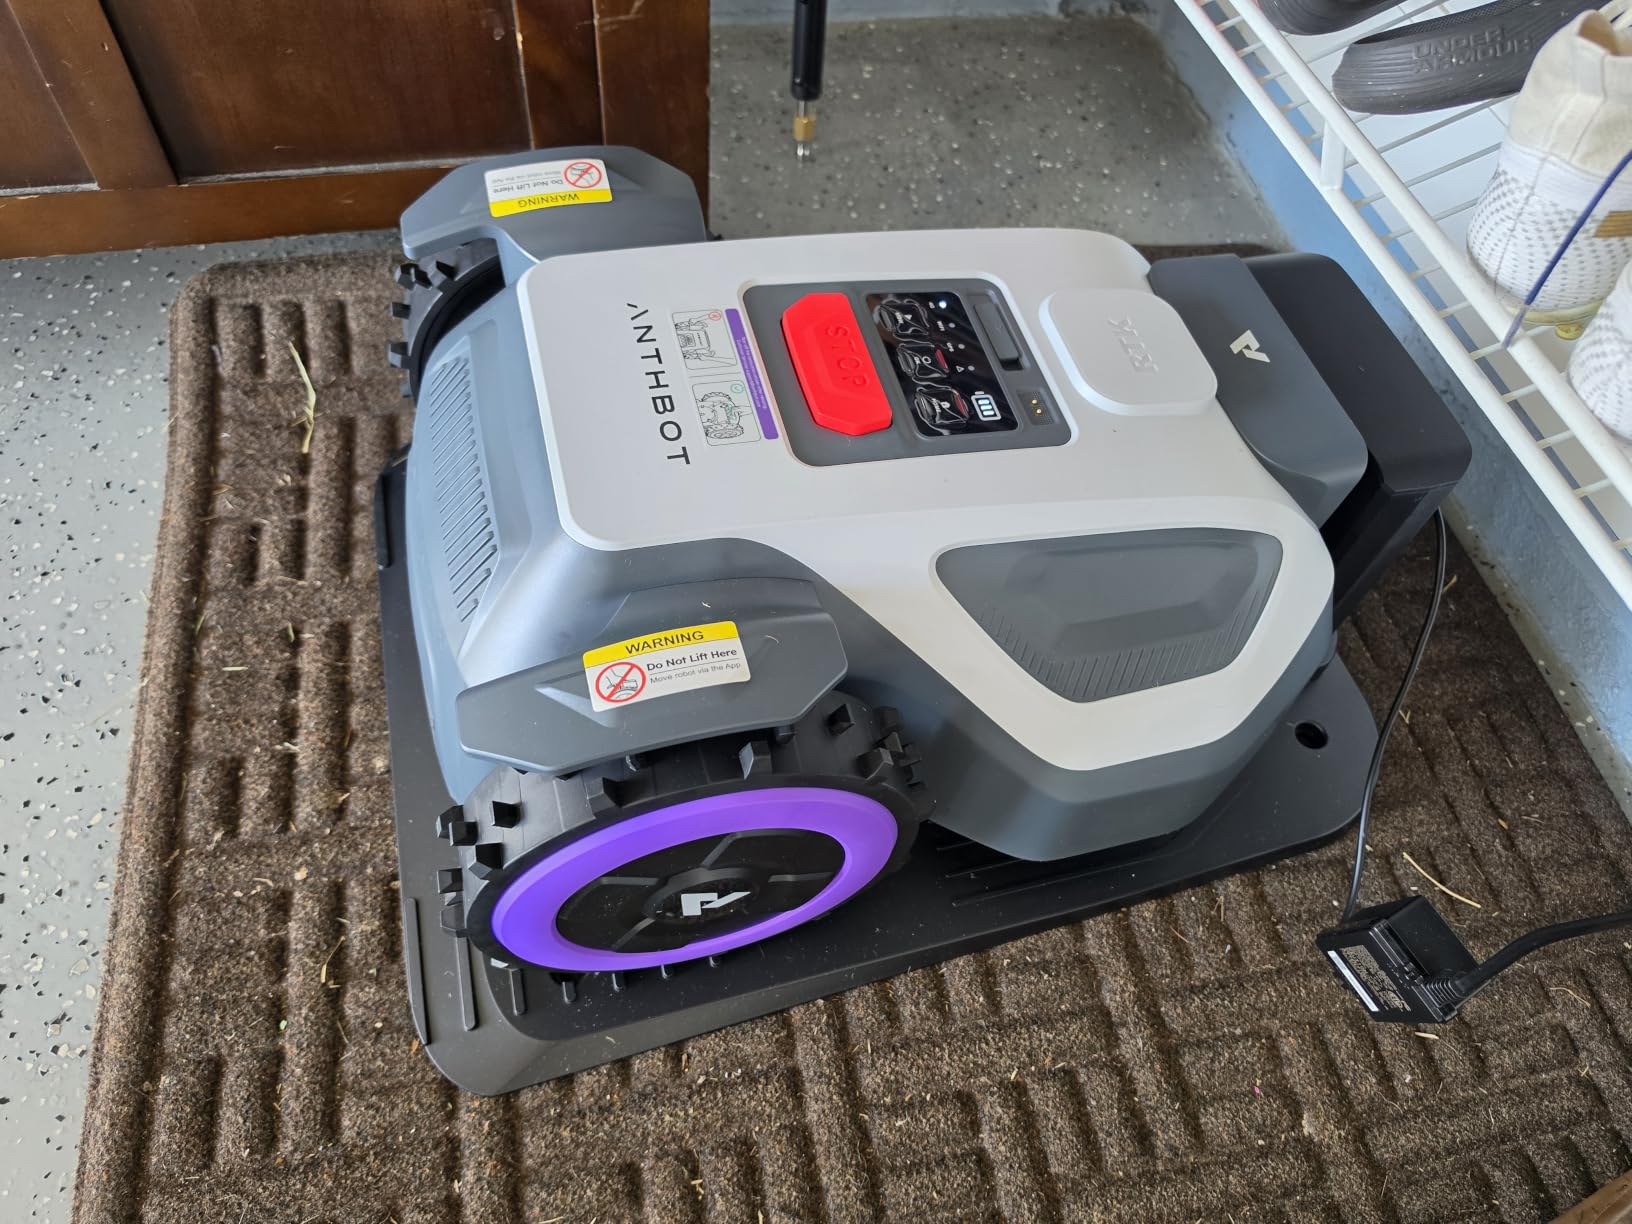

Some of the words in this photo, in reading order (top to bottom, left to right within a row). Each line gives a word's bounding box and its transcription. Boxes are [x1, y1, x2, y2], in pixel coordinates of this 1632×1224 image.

[1412, 28, 1503, 59] UNDER
[1414, 38, 1531, 73] ARMOUR
[492, 185, 514, 195] Here
[516, 183, 531, 192] Lift
[532, 180, 549, 189] Not
[549, 178, 563, 186] Do
[517, 192, 580, 208] WARNING
[825, 325, 868, 386] STOP
[947, 341, 955, 353] GPS
[626, 303, 690, 465] ANTHBOT
[931, 397, 941, 412] HOME
[626, 630, 704, 655] WARNING
[646, 662, 663, 672] Do
[665, 657, 687, 668] Not
[691, 652, 709, 663] Lift
[711, 648, 738, 660] Here
[650, 674, 673, 685] Move
[674, 670, 696, 679] robot
[698, 667, 709, 675] via
[710, 663, 724, 672] the
[725, 662, 741, 673] App
